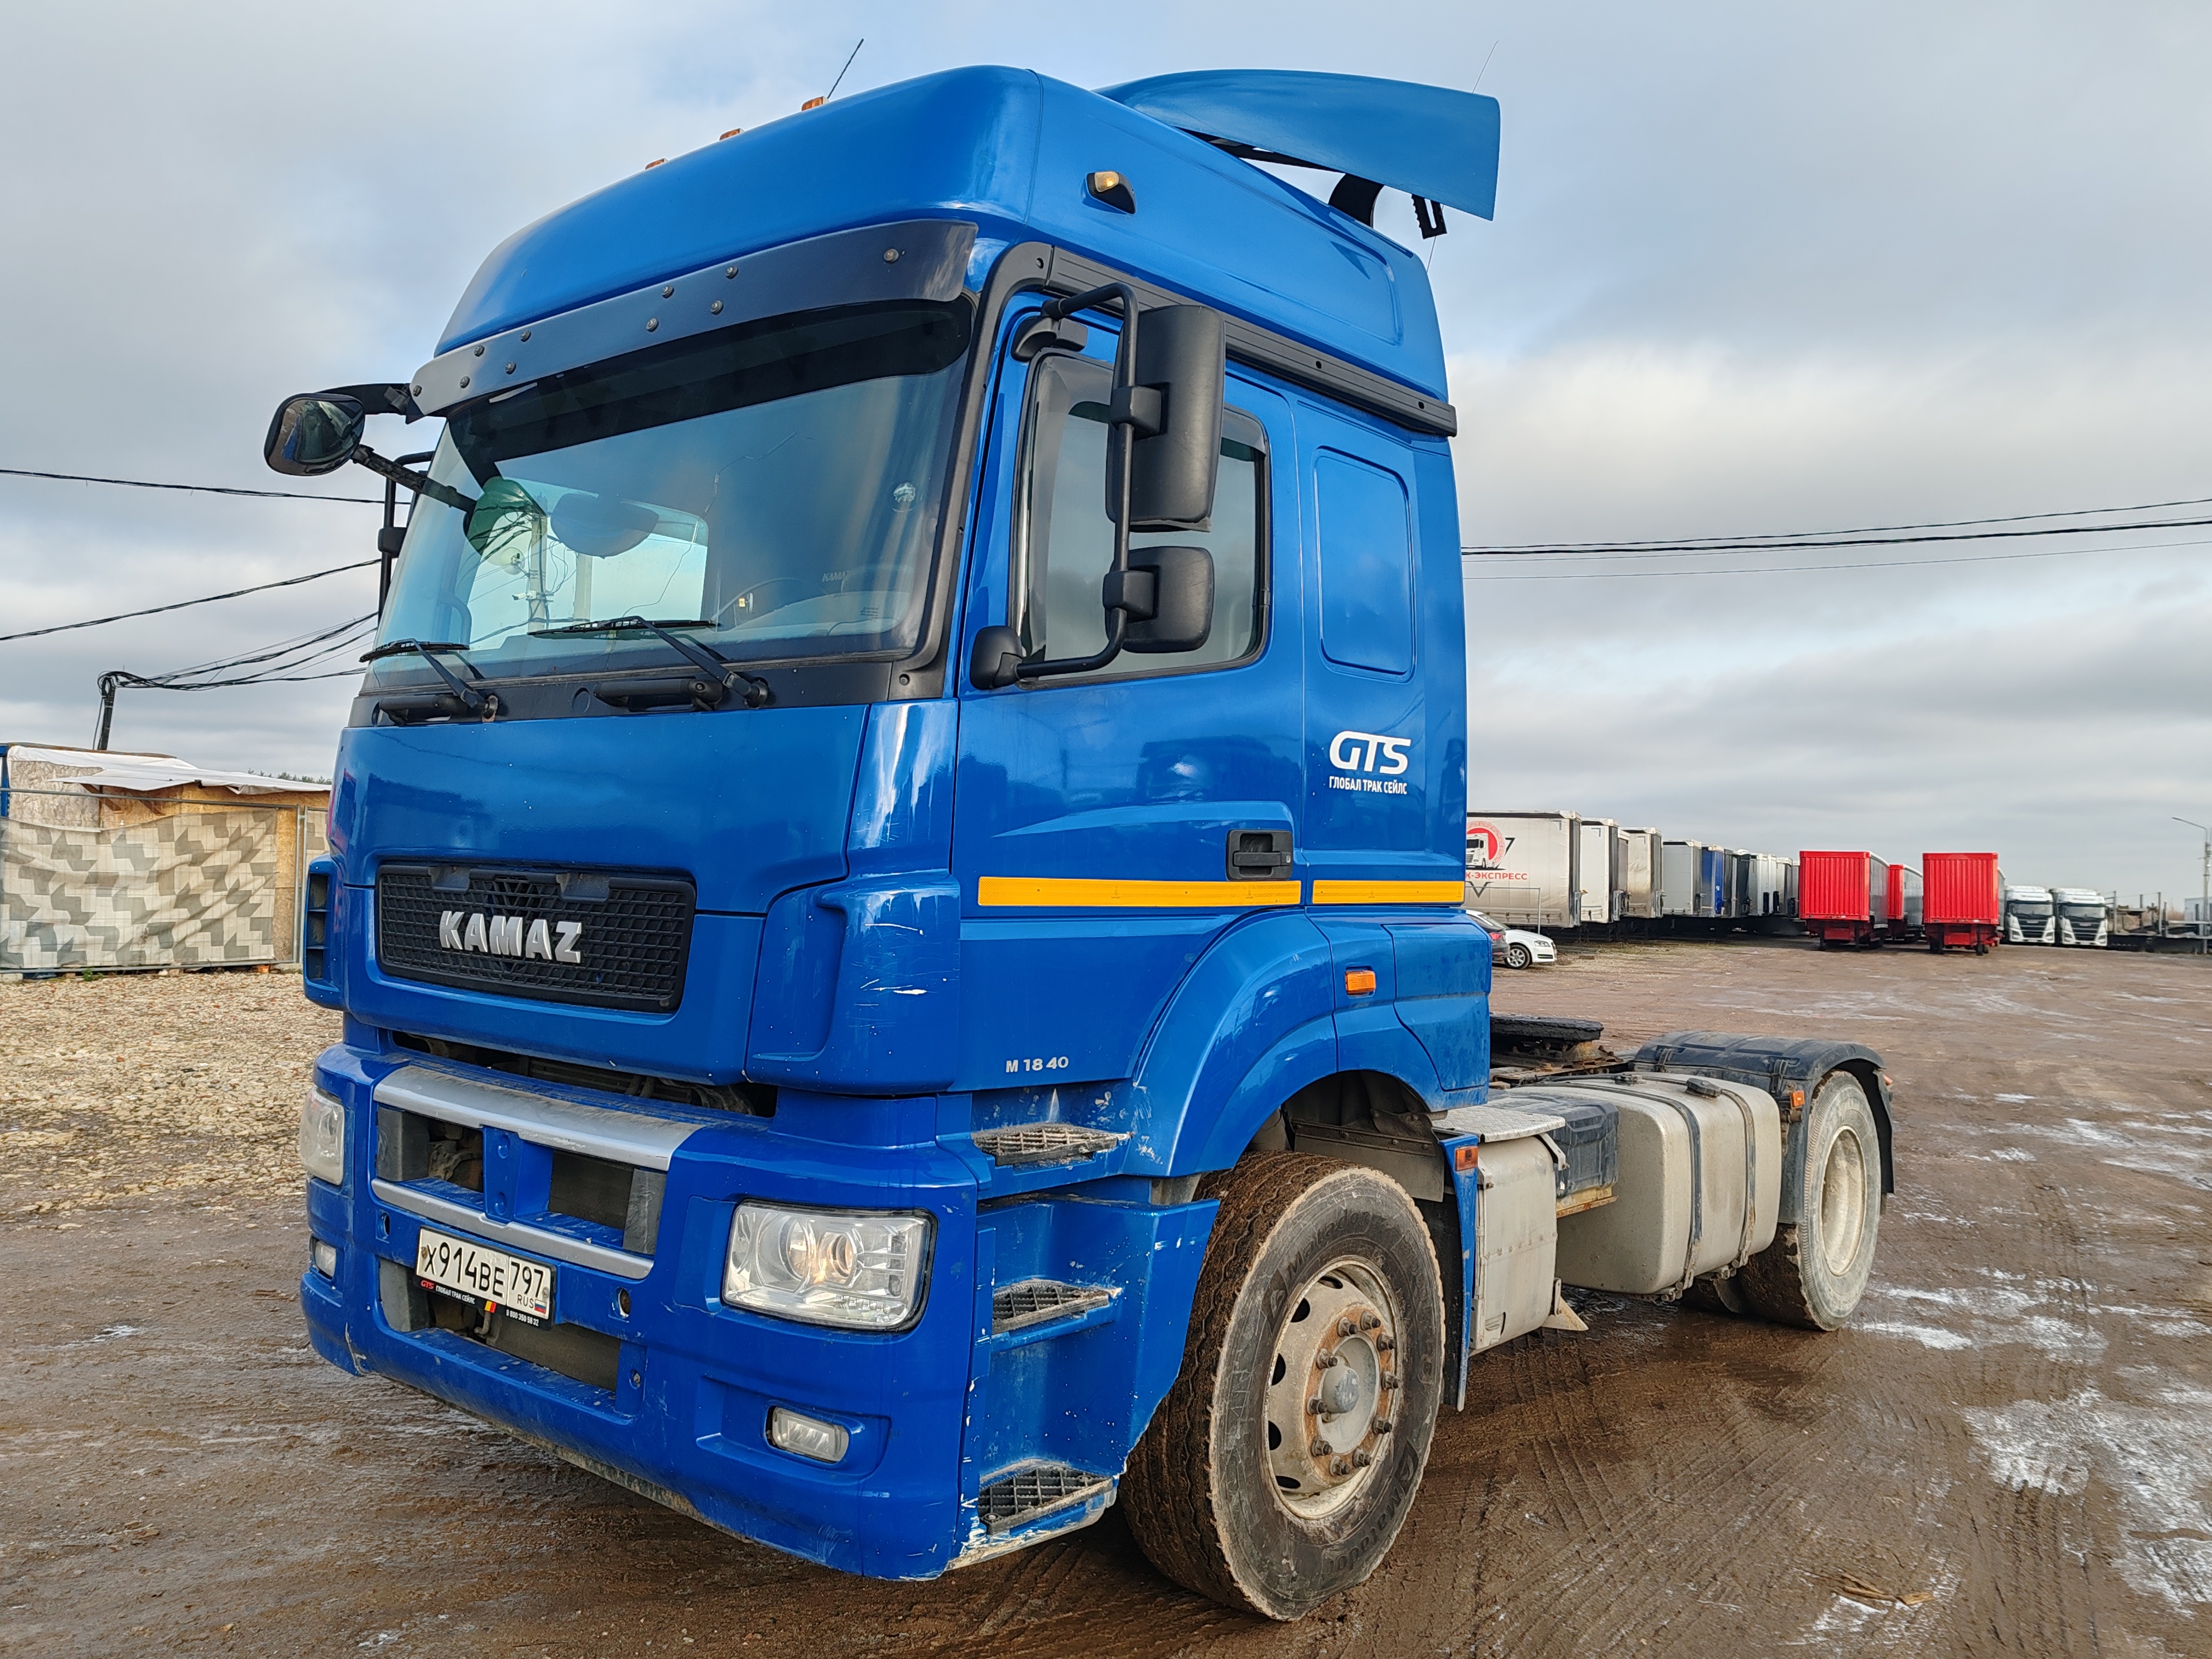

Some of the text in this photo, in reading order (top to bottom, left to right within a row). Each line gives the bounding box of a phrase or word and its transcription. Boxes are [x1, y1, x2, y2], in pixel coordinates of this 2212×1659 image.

[1329, 730, 1411, 775] GTS
[1329, 776, 1408, 795] ГЛОБАЛ ТРАК СЕЙЛС
[439, 910, 582, 964] KAMAZ
[421, 1280, 435, 1290] GTS
[511, 1261, 545, 1299] 797
[435, 1285, 475, 1305] ГЛОБАЛ ТРАК СЕЙЛС
[517, 1294, 534, 1309] RUS
[509, 1310, 518, 1319] 800
[518, 1313, 527, 1322] 350
[527, 1316, 533, 1324] 58
[533, 1318, 539, 1326] 32
